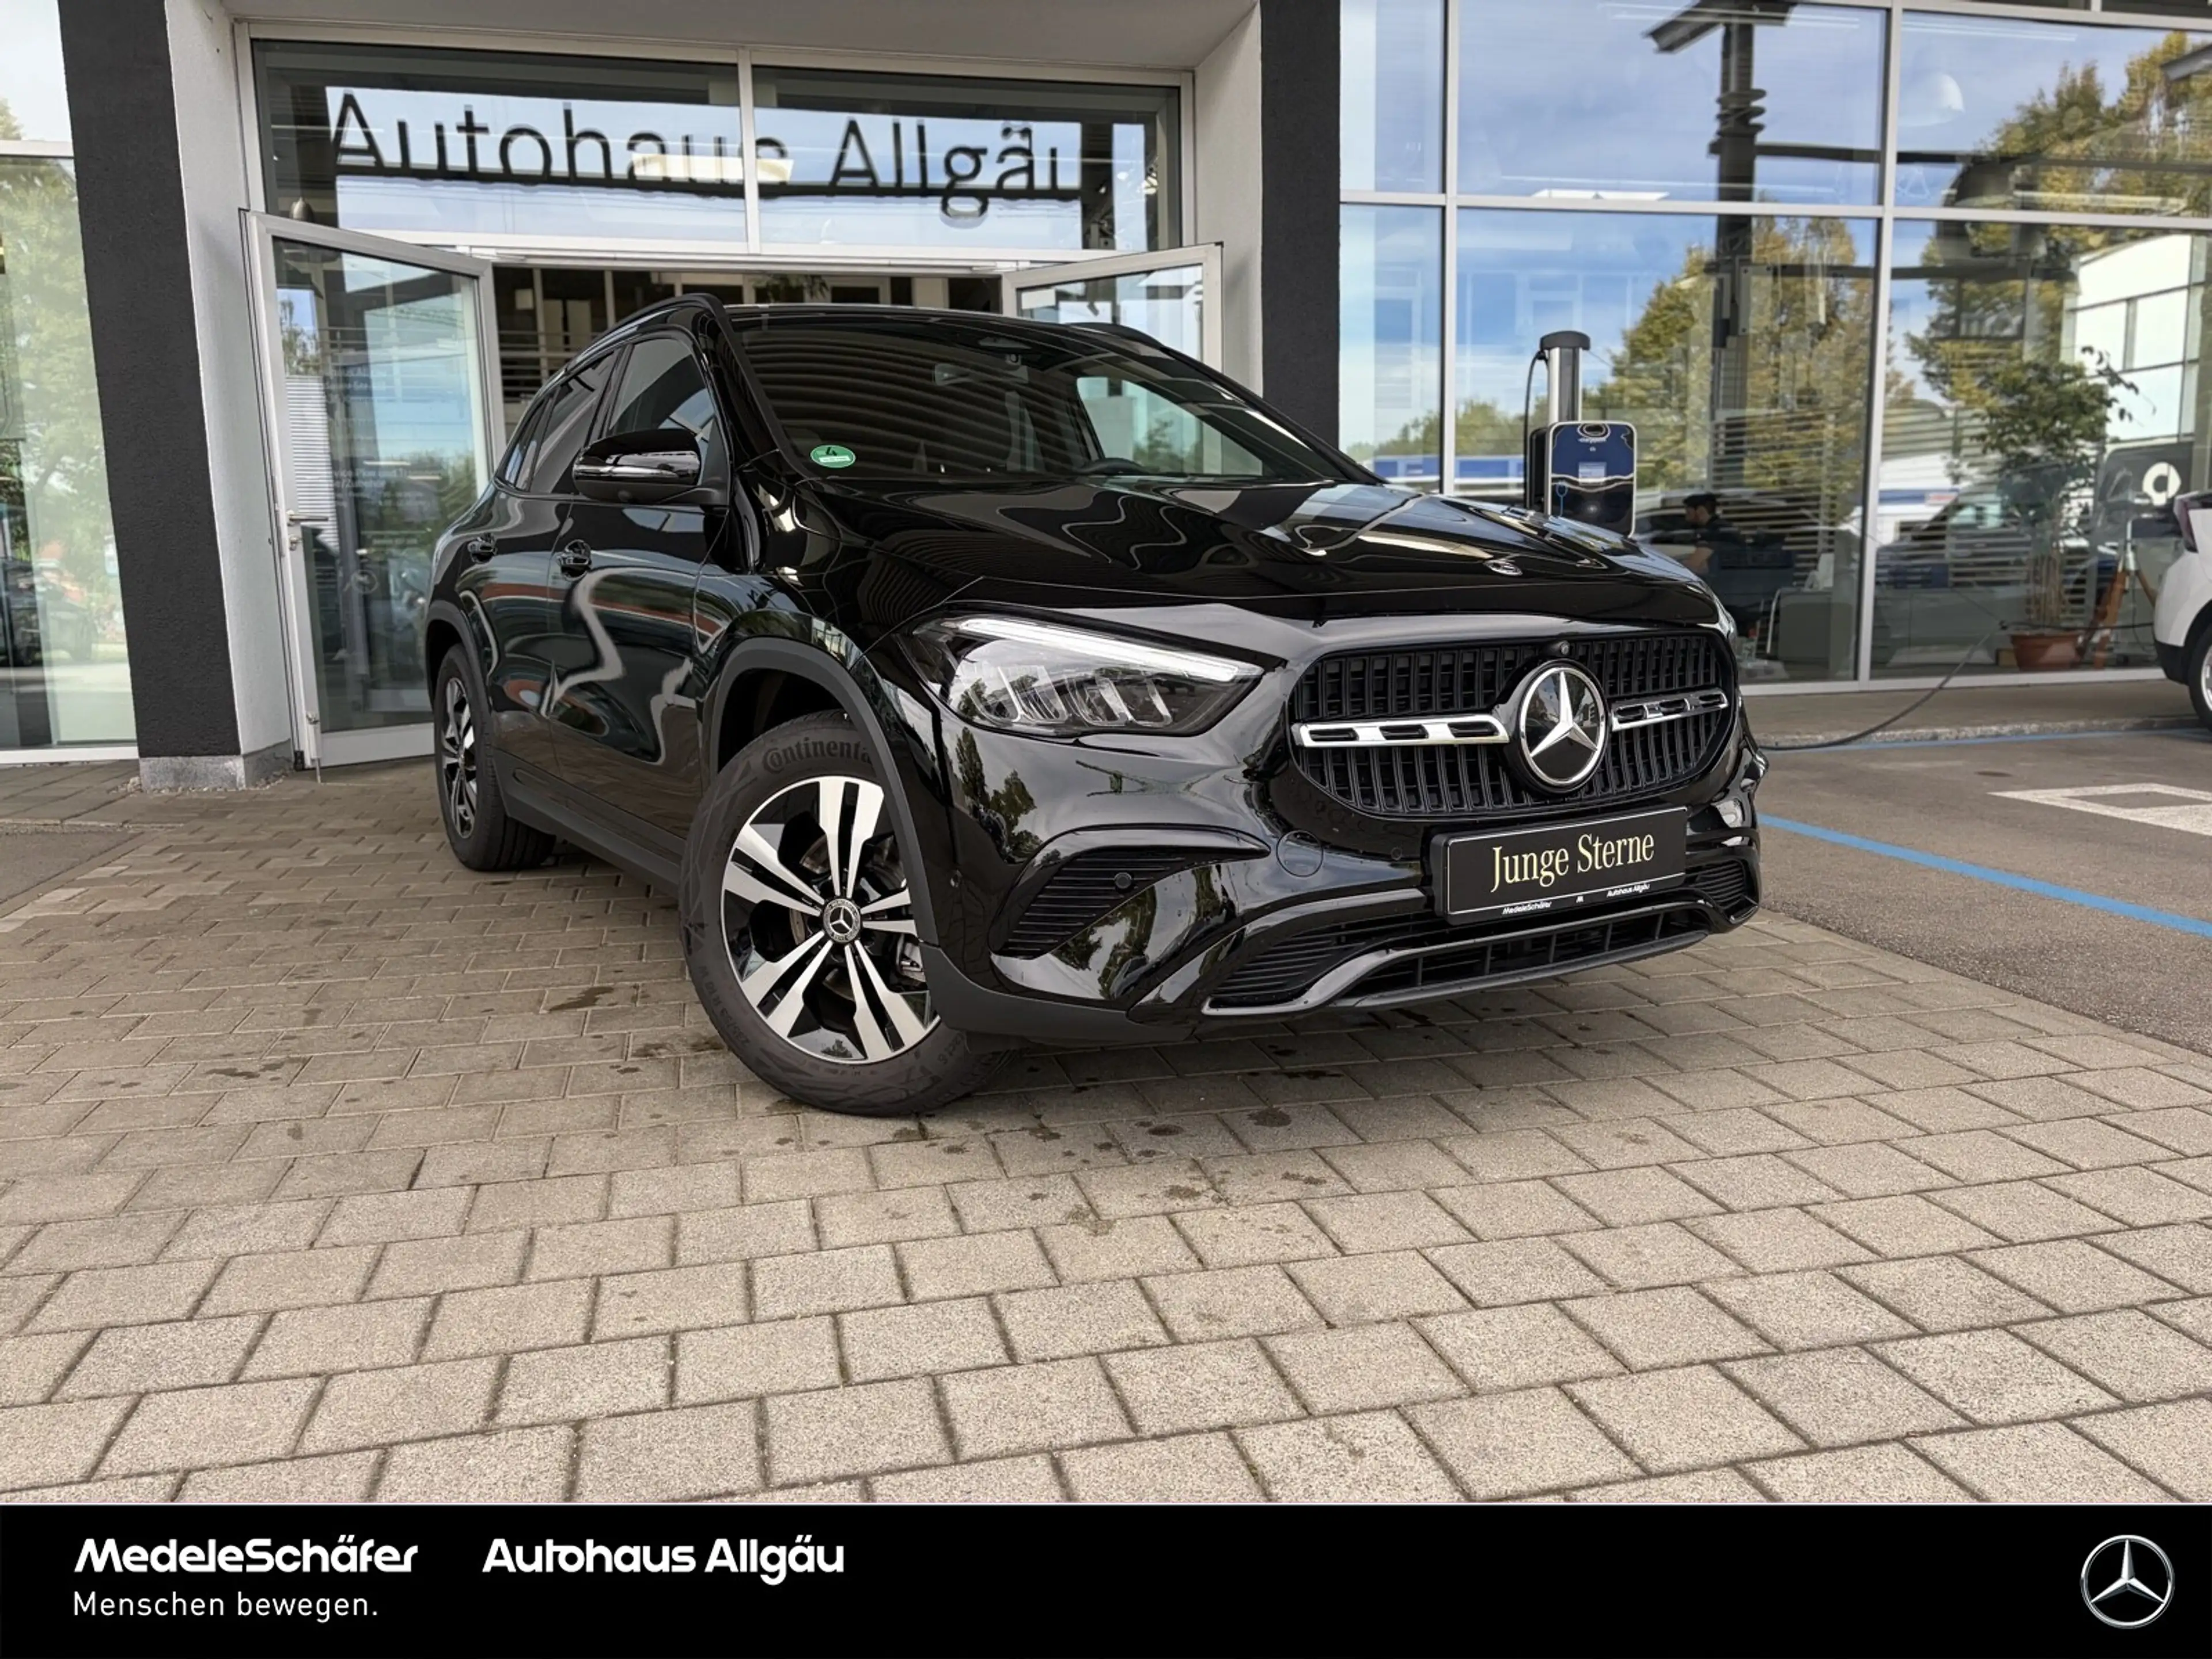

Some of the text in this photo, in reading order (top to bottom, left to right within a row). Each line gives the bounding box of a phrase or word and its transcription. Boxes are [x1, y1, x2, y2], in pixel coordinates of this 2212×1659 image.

[332, 90, 787, 198] Autohaus
[762, 737, 873, 774] Continenta
[1491, 832, 1654, 892] Junge Sterne
